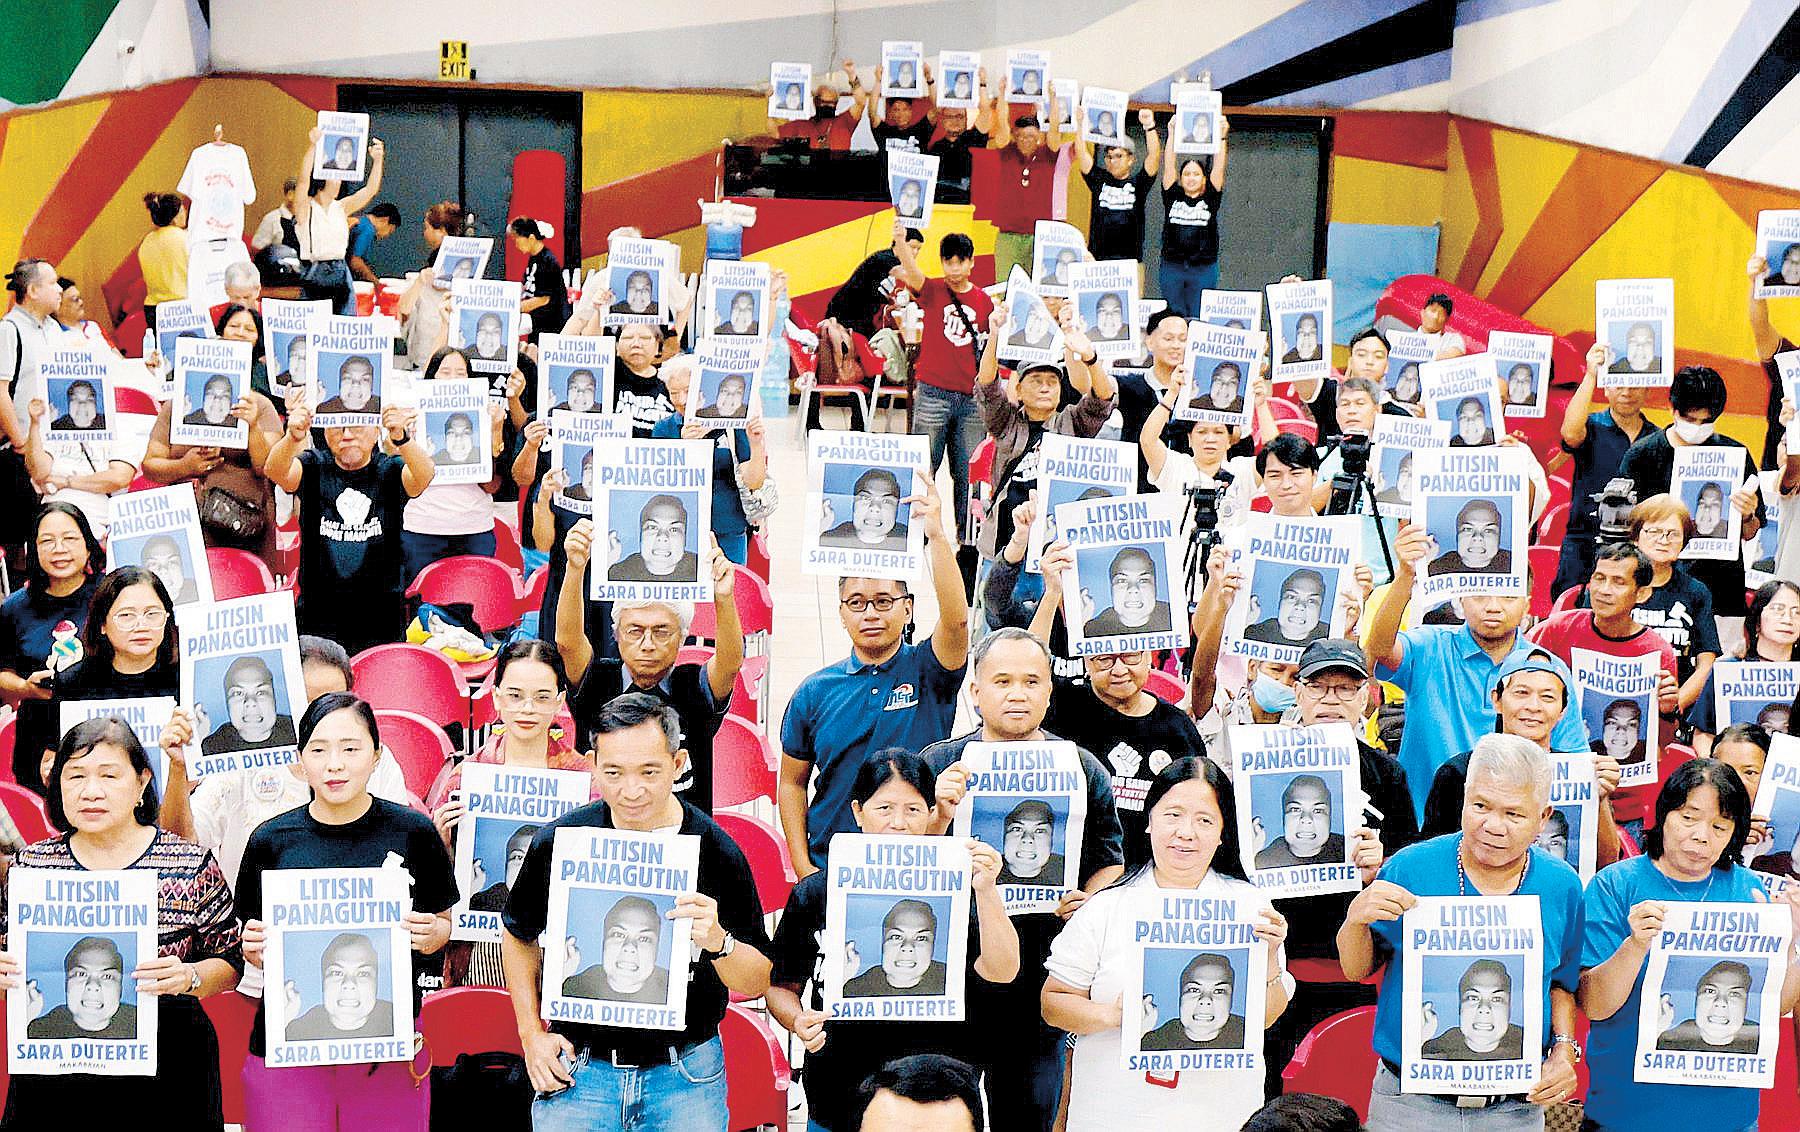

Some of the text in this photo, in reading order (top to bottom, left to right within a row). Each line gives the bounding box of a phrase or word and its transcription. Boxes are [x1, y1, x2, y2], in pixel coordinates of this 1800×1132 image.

[442, 61, 465, 76] EXIT
[1778, 217, 1800, 227] LITIS
[1764, 228, 1800, 237] PANAG
[620, 243, 652, 254] LITISIN
[612, 254, 664, 267] ANAGUTIN
[724, 266, 756, 276] LITISIN
[1085, 266, 1119, 276] LITISIN
[712, 276, 766, 288] PANAGUTIN
[1073, 277, 1133, 289] PANAGUTIN
[469, 285, 504, 295] LITISIN
[1285, 286, 1316, 298] LITISIN
[1780, 288, 1800, 296] DUTE
[455, 296, 515, 308] PANAGUTIN
[1217, 296, 1246, 305] LITISIN
[1275, 299, 1327, 310] PANAGUTIN
[1617, 296, 1653, 305] LITISIN
[164, 304, 192, 317] LITISIN
[1205, 304, 1256, 316] PANAGUTIN
[1603, 307, 1667, 318] PANAGUTIN
[267, 319, 307, 330] PANAG
[604, 315, 625, 324] SARA
[329, 322, 373, 335] LITISIN
[313, 336, 388, 350] PANAGUTIN
[558, 340, 596, 352] LITISIN
[1207, 333, 1245, 346] LITISIN
[1399, 336, 1427, 346] LITISIN
[1504, 336, 1535, 348] LITISIN
[195, 344, 234, 357] LITISIN
[713, 347, 750, 359] LITISIN
[1102, 342, 1136, 352] DUTERTE
[1191, 342, 1257, 359] PANAGUTIN
[1391, 346, 1434, 358] ANAGUTIN
[1492, 347, 1546, 360] PANAGUTIN
[54, 352, 92, 363] LITISIN
[181, 357, 246, 370] PANAGUTIN
[544, 351, 609, 365] PANAGUTIN
[699, 357, 760, 370] PANAGUTIN
[41, 364, 107, 376] PANAGUTIN
[1275, 363, 1327, 374] SARA DUTERTE
[1440, 368, 1477, 384] LITISIN
[1628, 377, 1667, 385] DUTERTE
[432, 384, 470, 395] LITISIN
[1429, 377, 1493, 398] PANAGUTIN
[420, 396, 484, 408] PANAGUTIN
[341, 416, 381, 425] DUTERT
[572, 418, 613, 430] LITISIN
[1181, 409, 1247, 425] SARA DUTERTE
[176, 427, 243, 440] SARA DUTERTE
[1394, 421, 1431, 435] LITISIN
[73, 432, 113, 440] DUTERTE
[840, 436, 899, 448] LITISIN
[1378, 433, 1444, 448] PANAGUTIN
[625, 447, 685, 465] LITISIN
[818, 446, 921, 463] PANAGUTIN
[1066, 444, 1118, 463] LITISIN
[1692, 452, 1725, 463] LITISIN
[448, 466, 487, 476] DUTERTE
[1045, 460, 1132, 482] PANAGUTIN
[1441, 456, 1498, 472] LITISIN
[602, 467, 705, 486] PANAGUTIN
[1678, 466, 1738, 477] PANAGUTIN
[1420, 474, 1520, 492] PANAGUTIN
[117, 495, 170, 517] LITISIN
[557, 498, 578, 511] SARA
[1087, 502, 1148, 523] LITISIN
[1066, 520, 1172, 544] PANAGUTIN
[1274, 523, 1333, 544] LITISIN
[1250, 539, 1349, 564] PANAGUTIN
[1693, 541, 1734, 551] DUTERTE
[809, 550, 915, 568] SARA DUTERTE
[598, 585, 706, 599] SARA DUTERTE
[1424, 576, 1520, 594] SARA DUTERTE
[207, 604, 264, 631] LITISIN
[188, 624, 289, 656] PANAGUTIN
[1076, 634, 1182, 655] SARA DUTERTE
[1233, 642, 1268, 658] SARA
[1595, 658, 1642, 677] LITISIN
[1579, 669, 1656, 692] PANAGUTIN
[1741, 669, 1793, 681] LITISIN
[1723, 683, 1798, 697] PANAGUT
[1264, 728, 1326, 748] LITISIN
[195, 750, 299, 776] SARA DUTERT
[992, 750, 1055, 771] LITISIN
[1242, 747, 1350, 770] PANAGUTIN
[1621, 764, 1651, 777] TERTE
[494, 774, 558, 796] LITISIN
[966, 771, 1078, 792] PANAGUTIN
[590, 837, 664, 864] LITISIN
[866, 844, 937, 867] LITISIN
[561, 860, 688, 891] PANAGUTIN
[838, 867, 962, 891] PANAGUTIN
[1249, 866, 1355, 888] SARA DUTERTE
[46, 879, 119, 902] LITISIN
[300, 878, 373, 901] LITISIN
[273, 901, 400, 925] PANAGUTIN
[1005, 902, 1036, 910] KABAYAN
[1163, 898, 1236, 921] LITISIN
[18, 904, 147, 927] PANAGUTIN
[459, 914, 498, 929] SARA
[1440, 905, 1506, 926] LITISIN
[1691, 911, 1759, 932] LITISIN
[1135, 921, 1260, 944] PANAGUTIN
[1414, 928, 1533, 950] PANAGUTIN
[1661, 931, 1782, 952] PANAGUTIN
[550, 1001, 676, 1027] SARA DUTERTE
[832, 1000, 956, 1018] SARA DUTERTE
[17, 1044, 148, 1060] SARA DUTERTE
[274, 1041, 405, 1063] SARA DUTERTE
[1129, 1054, 1254, 1070] SARA DUTERTE
[1643, 1053, 1766, 1073] SARA DUTERTE
[1410, 1064, 1532, 1080] SARA DUTERTE
